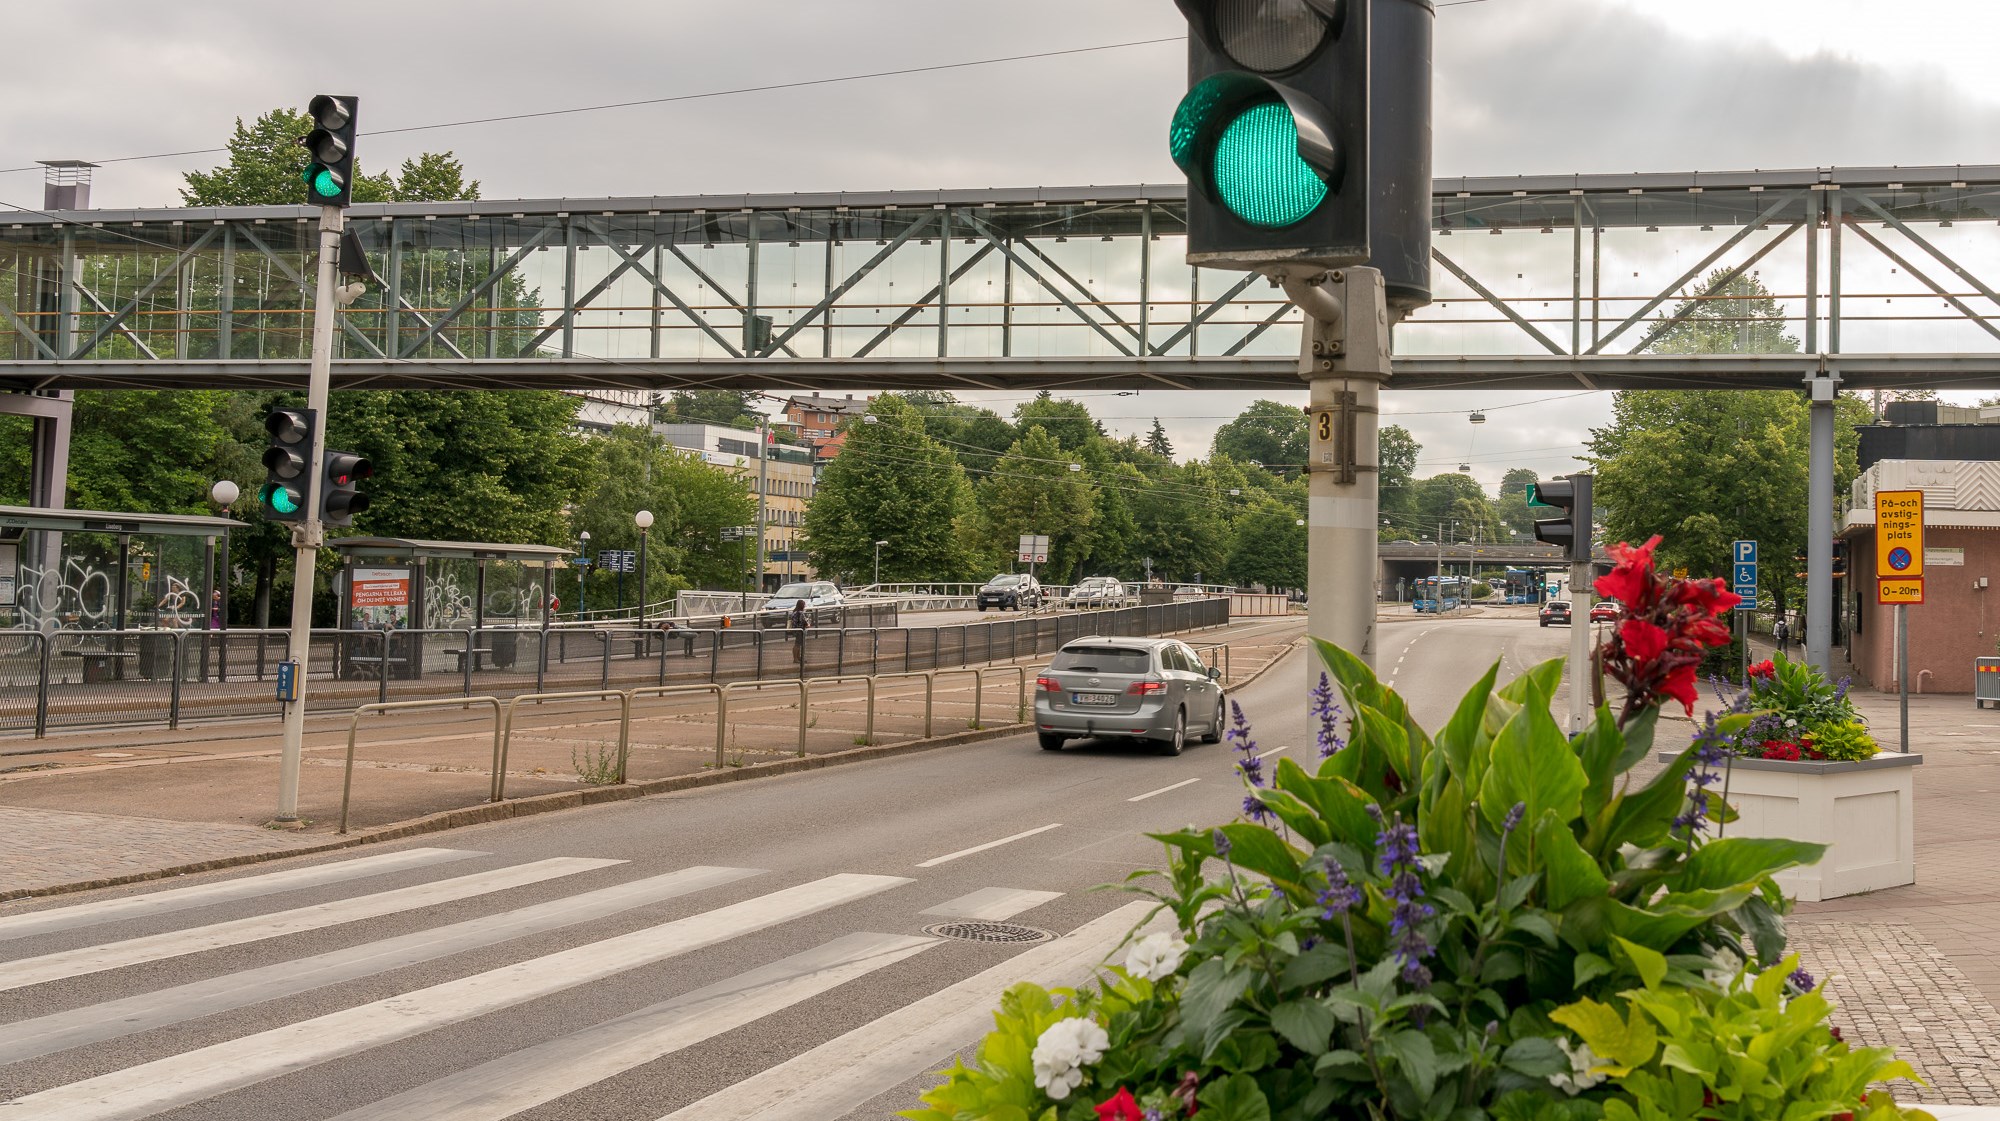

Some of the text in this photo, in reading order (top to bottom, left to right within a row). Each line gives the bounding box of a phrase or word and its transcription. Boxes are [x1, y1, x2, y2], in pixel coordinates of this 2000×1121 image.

[1320, 413, 1330, 440] 3
[1881, 510, 1918, 519] avstig-
[1883, 521, 1916, 530] nings-
[1887, 531, 1912, 541] plats
[1740, 543, 1753, 560] P
